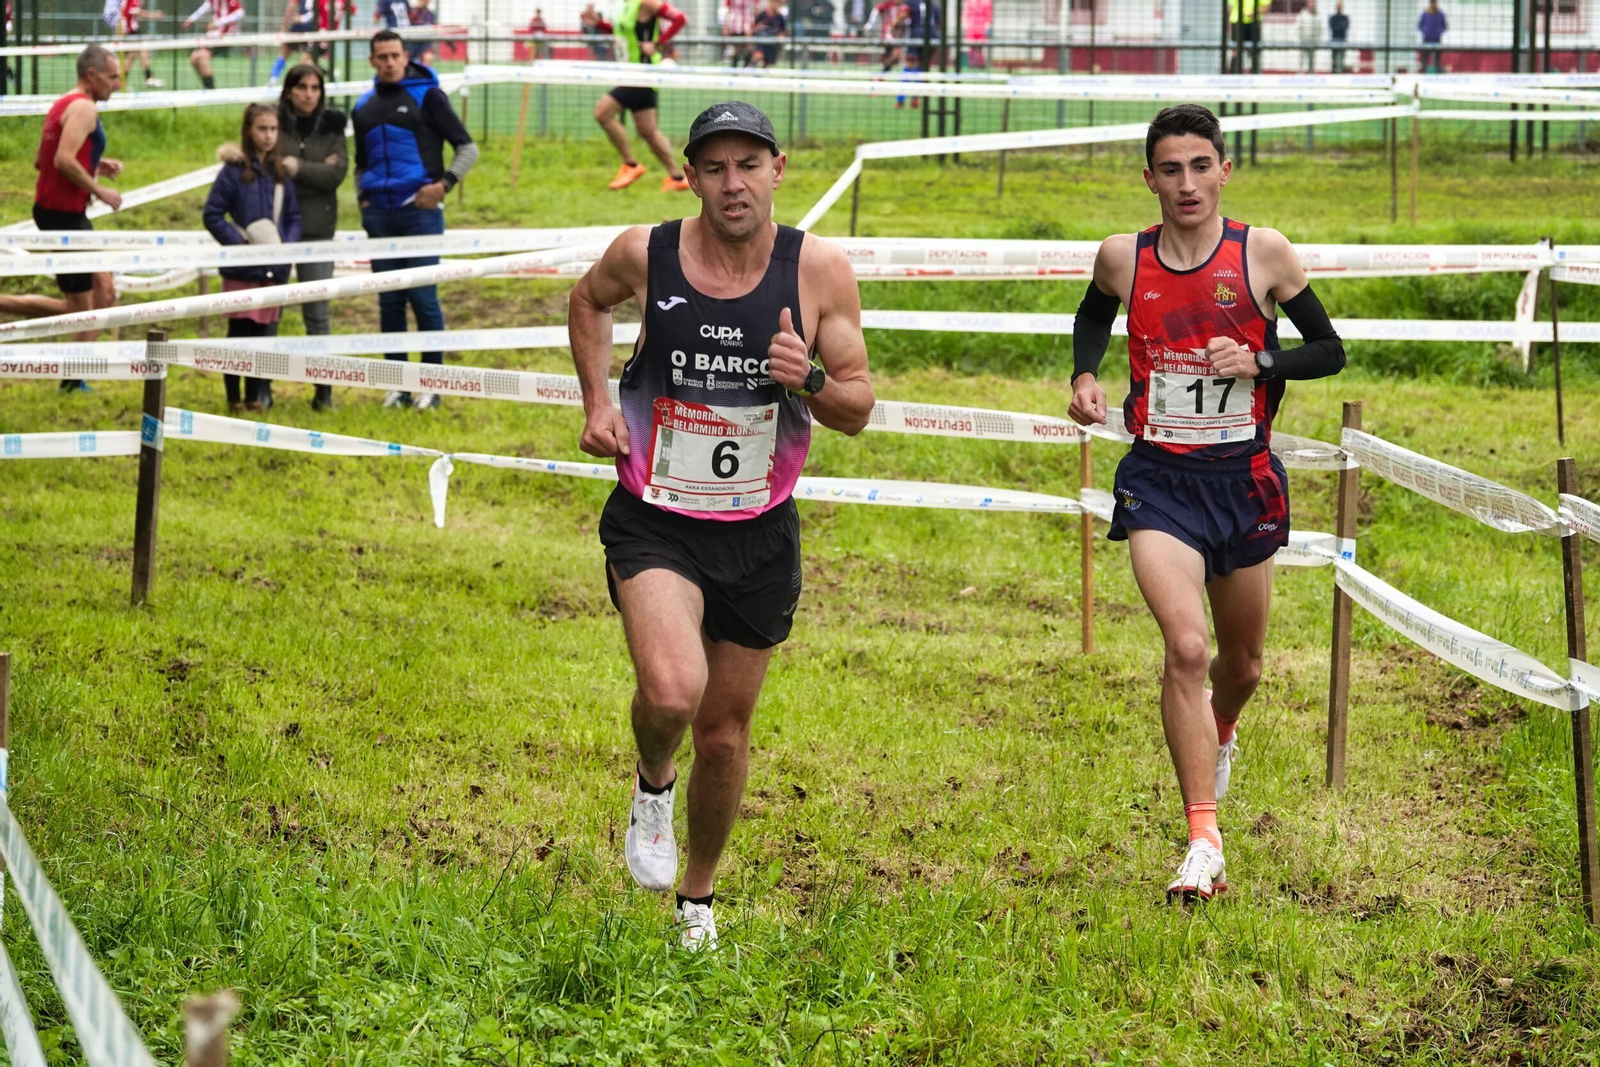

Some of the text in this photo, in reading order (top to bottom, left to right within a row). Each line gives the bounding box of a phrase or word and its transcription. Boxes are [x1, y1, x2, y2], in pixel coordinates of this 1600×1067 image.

[699, 324, 744, 341] CUPA
[720, 339, 744, 348] PIZARRAS
[193, 357, 253, 373] DEPUTACIÓN
[671, 349, 687, 368] O
[1163, 351, 1205, 363] MEMORIAL
[0, 362, 59, 374] DEPUTAC
[305, 366, 366, 383] DEPUTACIÓN
[418, 365, 483, 381] PONTEVEDRA
[1163, 363, 1208, 375] BELARMINO
[419, 376, 482, 393] DEPUTACIÓN
[1186, 377, 1237, 414] 17
[674, 405, 722, 422] MEMORIAL
[673, 418, 760, 436] BELARMINO ALONSO
[904, 417, 972, 433] DEPUTACIÓN
[711, 440, 740, 479] 6
